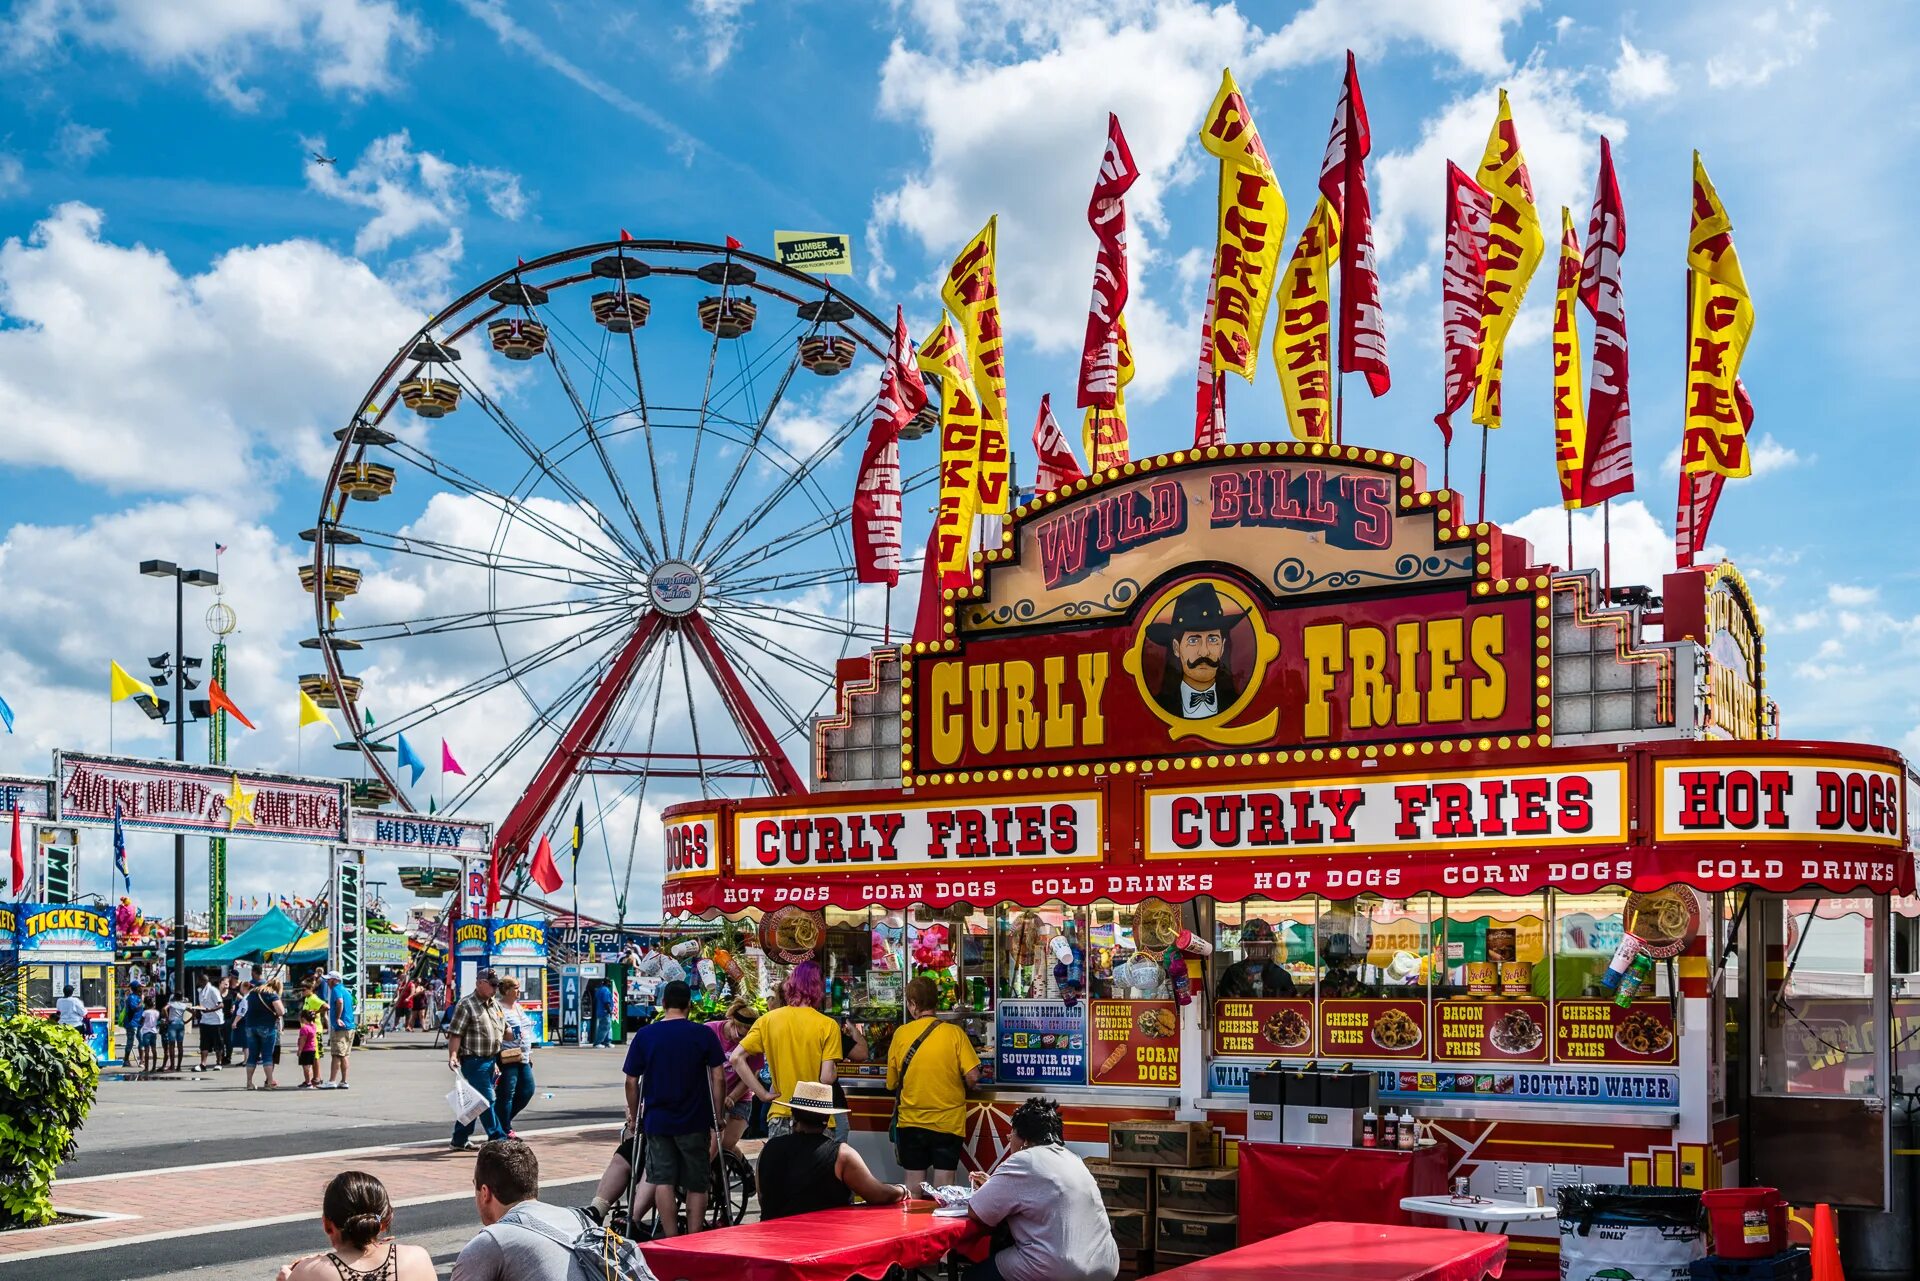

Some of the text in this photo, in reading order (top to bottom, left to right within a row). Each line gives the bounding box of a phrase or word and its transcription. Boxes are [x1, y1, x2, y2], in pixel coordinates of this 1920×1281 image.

[786, 248, 839, 261] LIQUIDATORS
[794, 241, 827, 252] LUMBER
[1035, 467, 1392, 590] WILD BILL'S
[931, 651, 1110, 765] CURLY
[1303, 613, 1506, 740] FRIES
[62, 764, 226, 822] AMUSEMENTS
[253, 788, 341, 830] AMERICA
[1679, 769, 1897, 836] HOT DOGS
[1171, 775, 1594, 850] CURLY FRIES
[376, 819, 465, 848] MIDWAY
[755, 803, 1079, 866] CURLY FRIES
[666, 823, 708, 872] DOGS
[1443, 861, 1632, 884] CORN DOGS
[1697, 859, 1894, 881] COLD DRINKS
[1031, 874, 1213, 895] COLD DRINKS
[1253, 868, 1401, 889] HOT DOGS
[724, 886, 830, 903] HOT DOGS
[862, 881, 996, 900] CORN DOGS
[0, 909, 16, 933] ETS
[26, 908, 110, 938] TICKETS
[456, 923, 487, 943] TICKETS
[494, 924, 544, 946] TICKETS
[562, 929, 619, 944] Wheel
[1470, 968, 1493, 982] Gehl's
[1503, 968, 1528, 982] Gehl's
[564, 977, 578, 1026] ATM
[1002, 1006, 1082, 1018] WILD BILL'S REFILL CLUB
[1095, 1005, 1132, 1017] CHICKEN
[1224, 1004, 1253, 1017] CHILI
[1443, 1006, 1484, 1021] BACON
[1562, 1006, 1611, 1021] CHEESE
[1095, 1017, 1133, 1029] TENDERS
[1218, 1020, 1259, 1034] CHEESE
[1326, 1013, 1369, 1027] CHEESE
[1098, 1029, 1130, 1041] BASKET
[1330, 1030, 1364, 1044] FRIES
[1442, 1024, 1485, 1038] RANCH
[1559, 1025, 1614, 1039] & BACON
[1223, 1037, 1255, 1050] FRIES
[1445, 1042, 1481, 1056] FRIES
[1567, 1043, 1605, 1057] FRIES
[1002, 1053, 1082, 1066] SOUVENIR CUP
[1136, 1046, 1179, 1063] CORN
[1016, 1066, 1072, 1076] $3.00 REFILLS
[1138, 1064, 1177, 1081] DOGS
[1215, 1066, 1250, 1087] WILD
[1518, 1073, 1600, 1097] BOTTLED
[1605, 1076, 1671, 1100] WATER
[1600, 1230, 1626, 1241] ONLY
